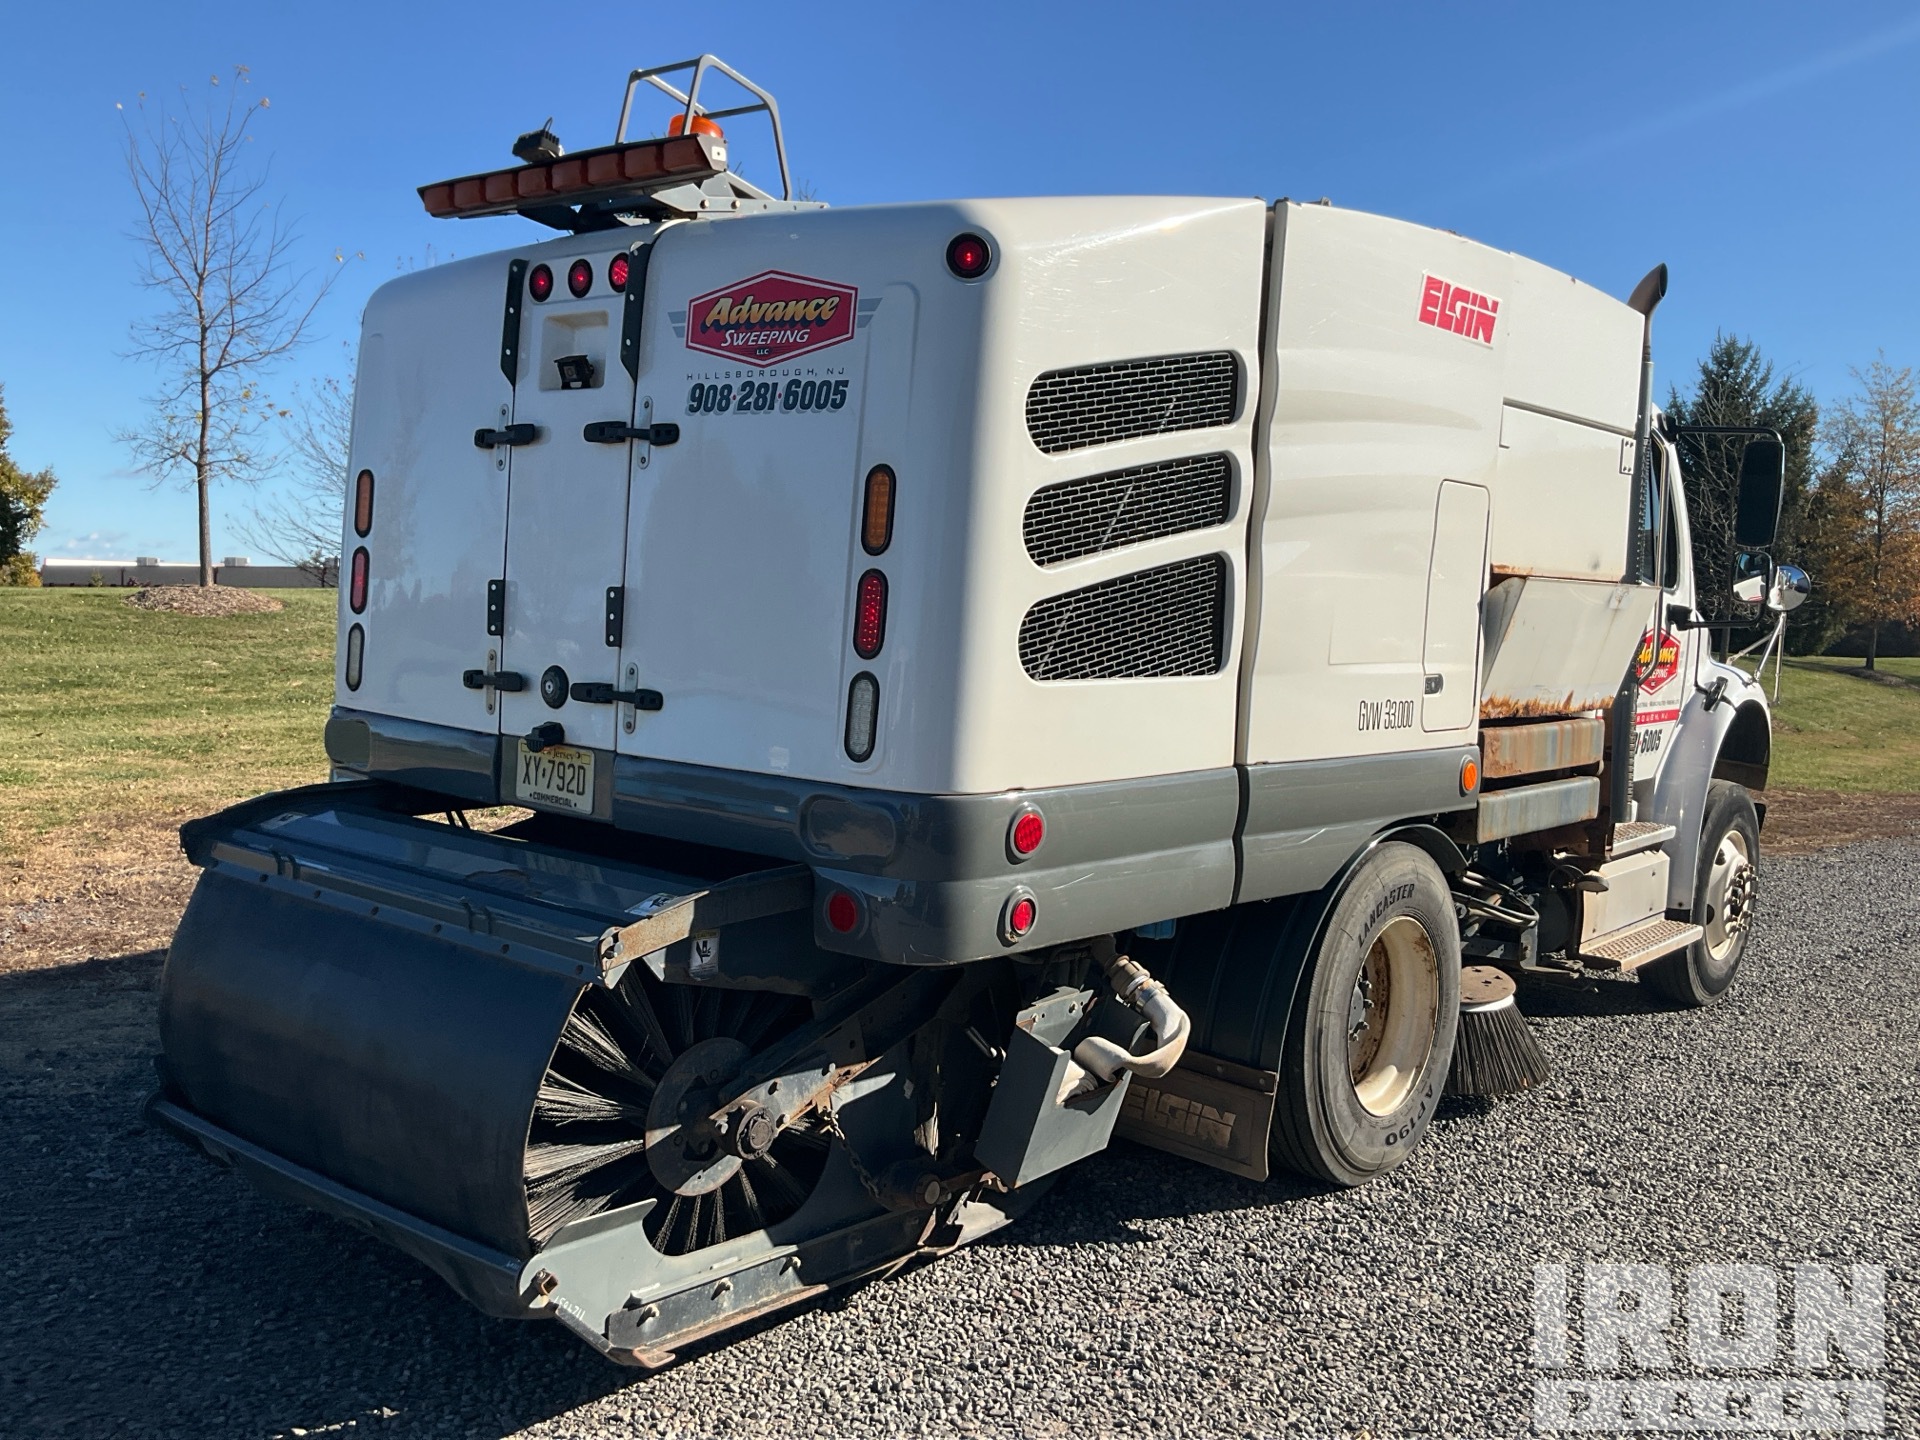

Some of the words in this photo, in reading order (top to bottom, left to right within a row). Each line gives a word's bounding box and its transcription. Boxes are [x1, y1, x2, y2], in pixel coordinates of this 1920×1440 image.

[703, 295, 840, 330] Advance
[1418, 274, 1500, 344] ELGIN
[720, 329, 811, 347] SWEEPING
[755, 348, 770, 356] LLC
[686, 368, 818, 380] HILLSBOROUGH,
[826, 367, 845, 375] NJ
[1358, 700, 1383, 731] GVW
[1384, 699, 1414, 730] 33,000
[532, 791, 573, 808] COMMERCIAL
[1358, 883, 1415, 948] LANCASTER
[1121, 1083, 1237, 1148] ELGIN
